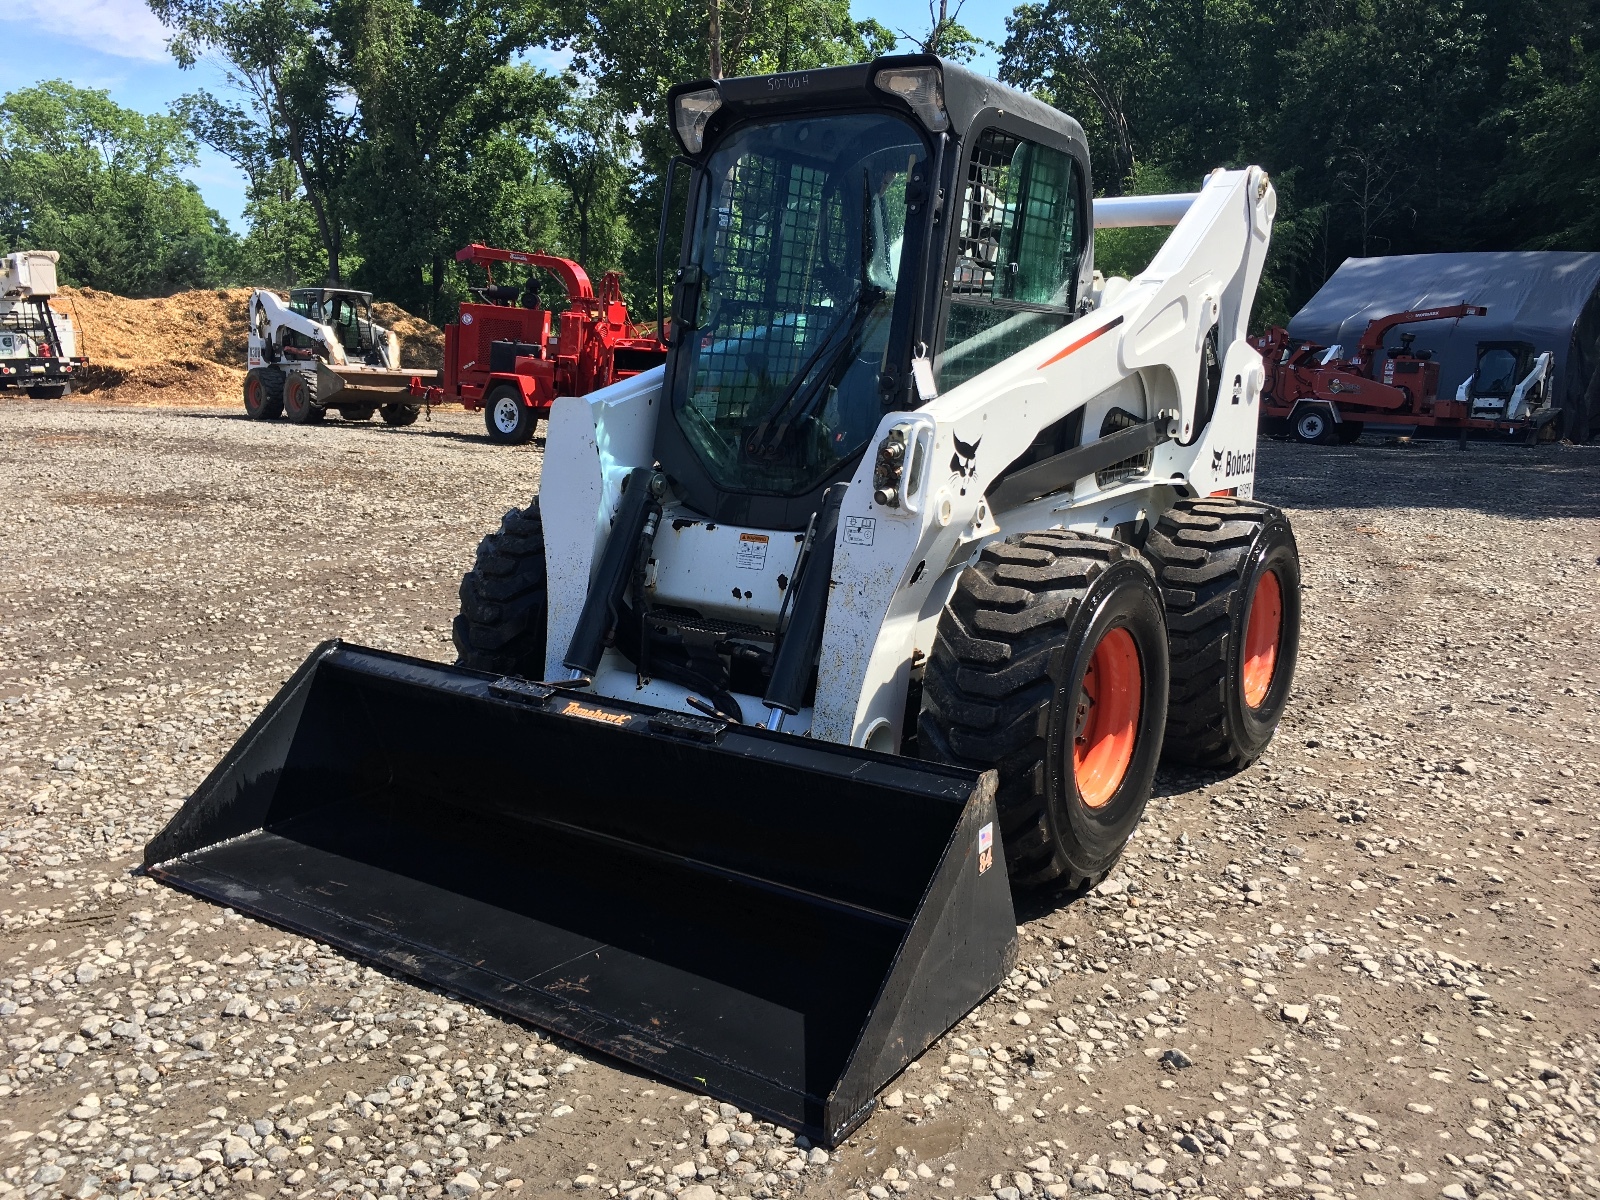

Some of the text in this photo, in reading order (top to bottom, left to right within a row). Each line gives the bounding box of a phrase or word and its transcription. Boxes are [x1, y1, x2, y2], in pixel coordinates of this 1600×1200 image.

[1225, 449, 1254, 477] Bobcat
[562, 701, 632, 724] Tomahawk
[979, 846, 993, 873] 84
